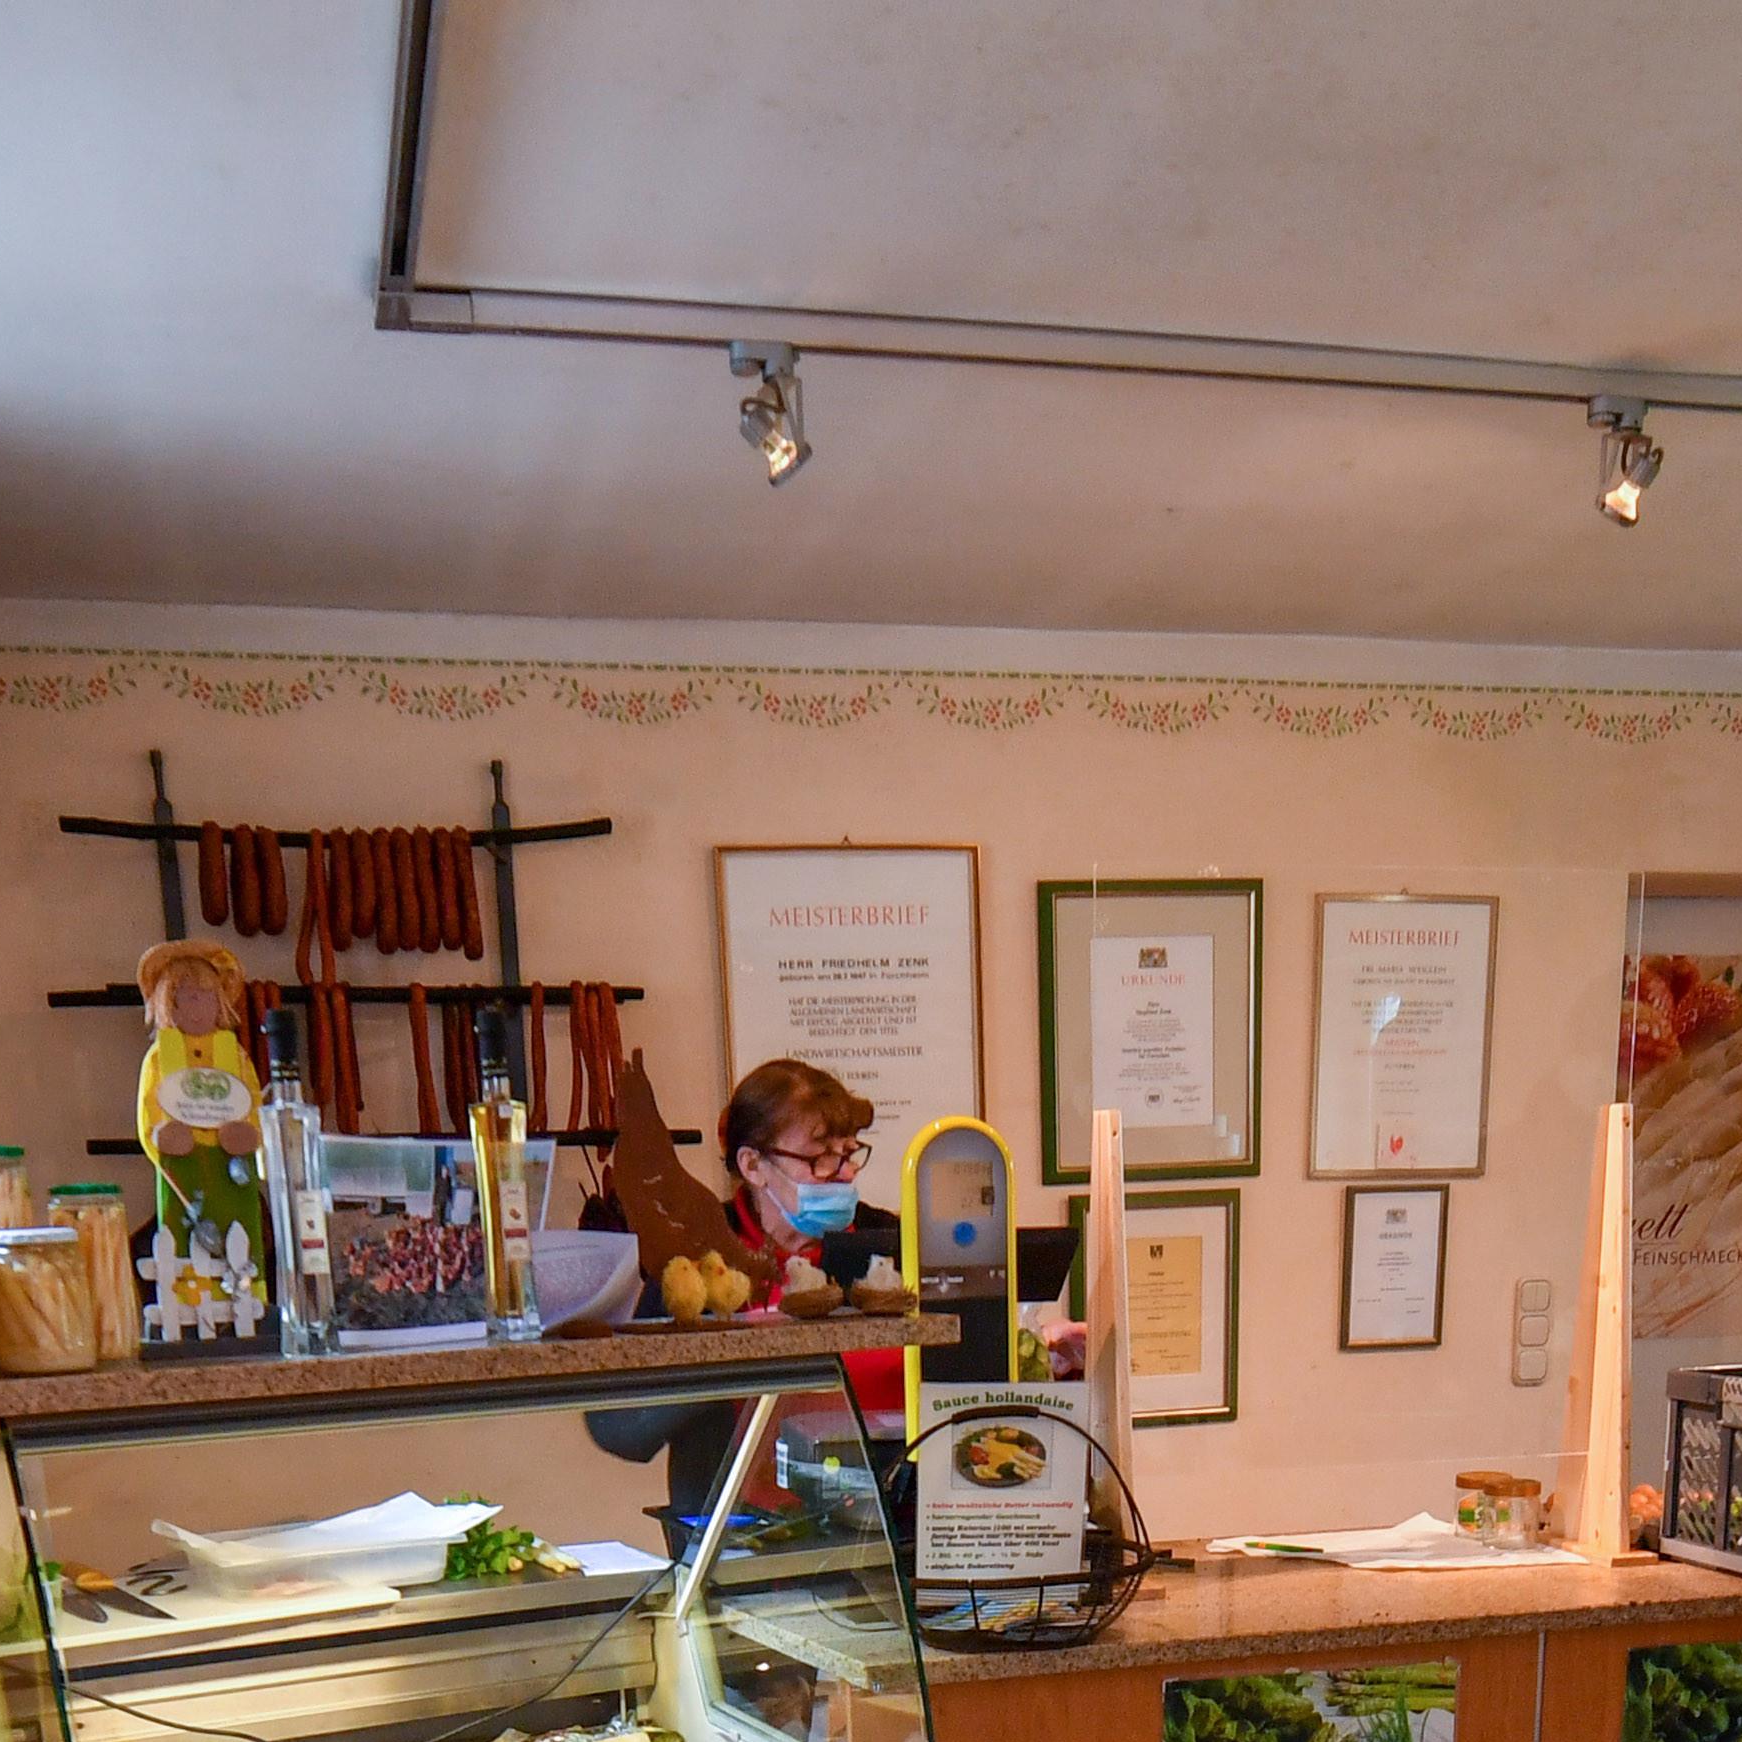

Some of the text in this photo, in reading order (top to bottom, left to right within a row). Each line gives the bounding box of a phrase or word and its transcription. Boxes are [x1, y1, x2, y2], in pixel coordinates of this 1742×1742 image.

[769, 904, 929, 927] MEISTERBRIEF
[1349, 930, 1460, 946] MEISTERBRIEF
[779, 957, 929, 969] HERR FRIEDHELM ZENK
[932, 1392, 1074, 1411] Sauce hollandaise
